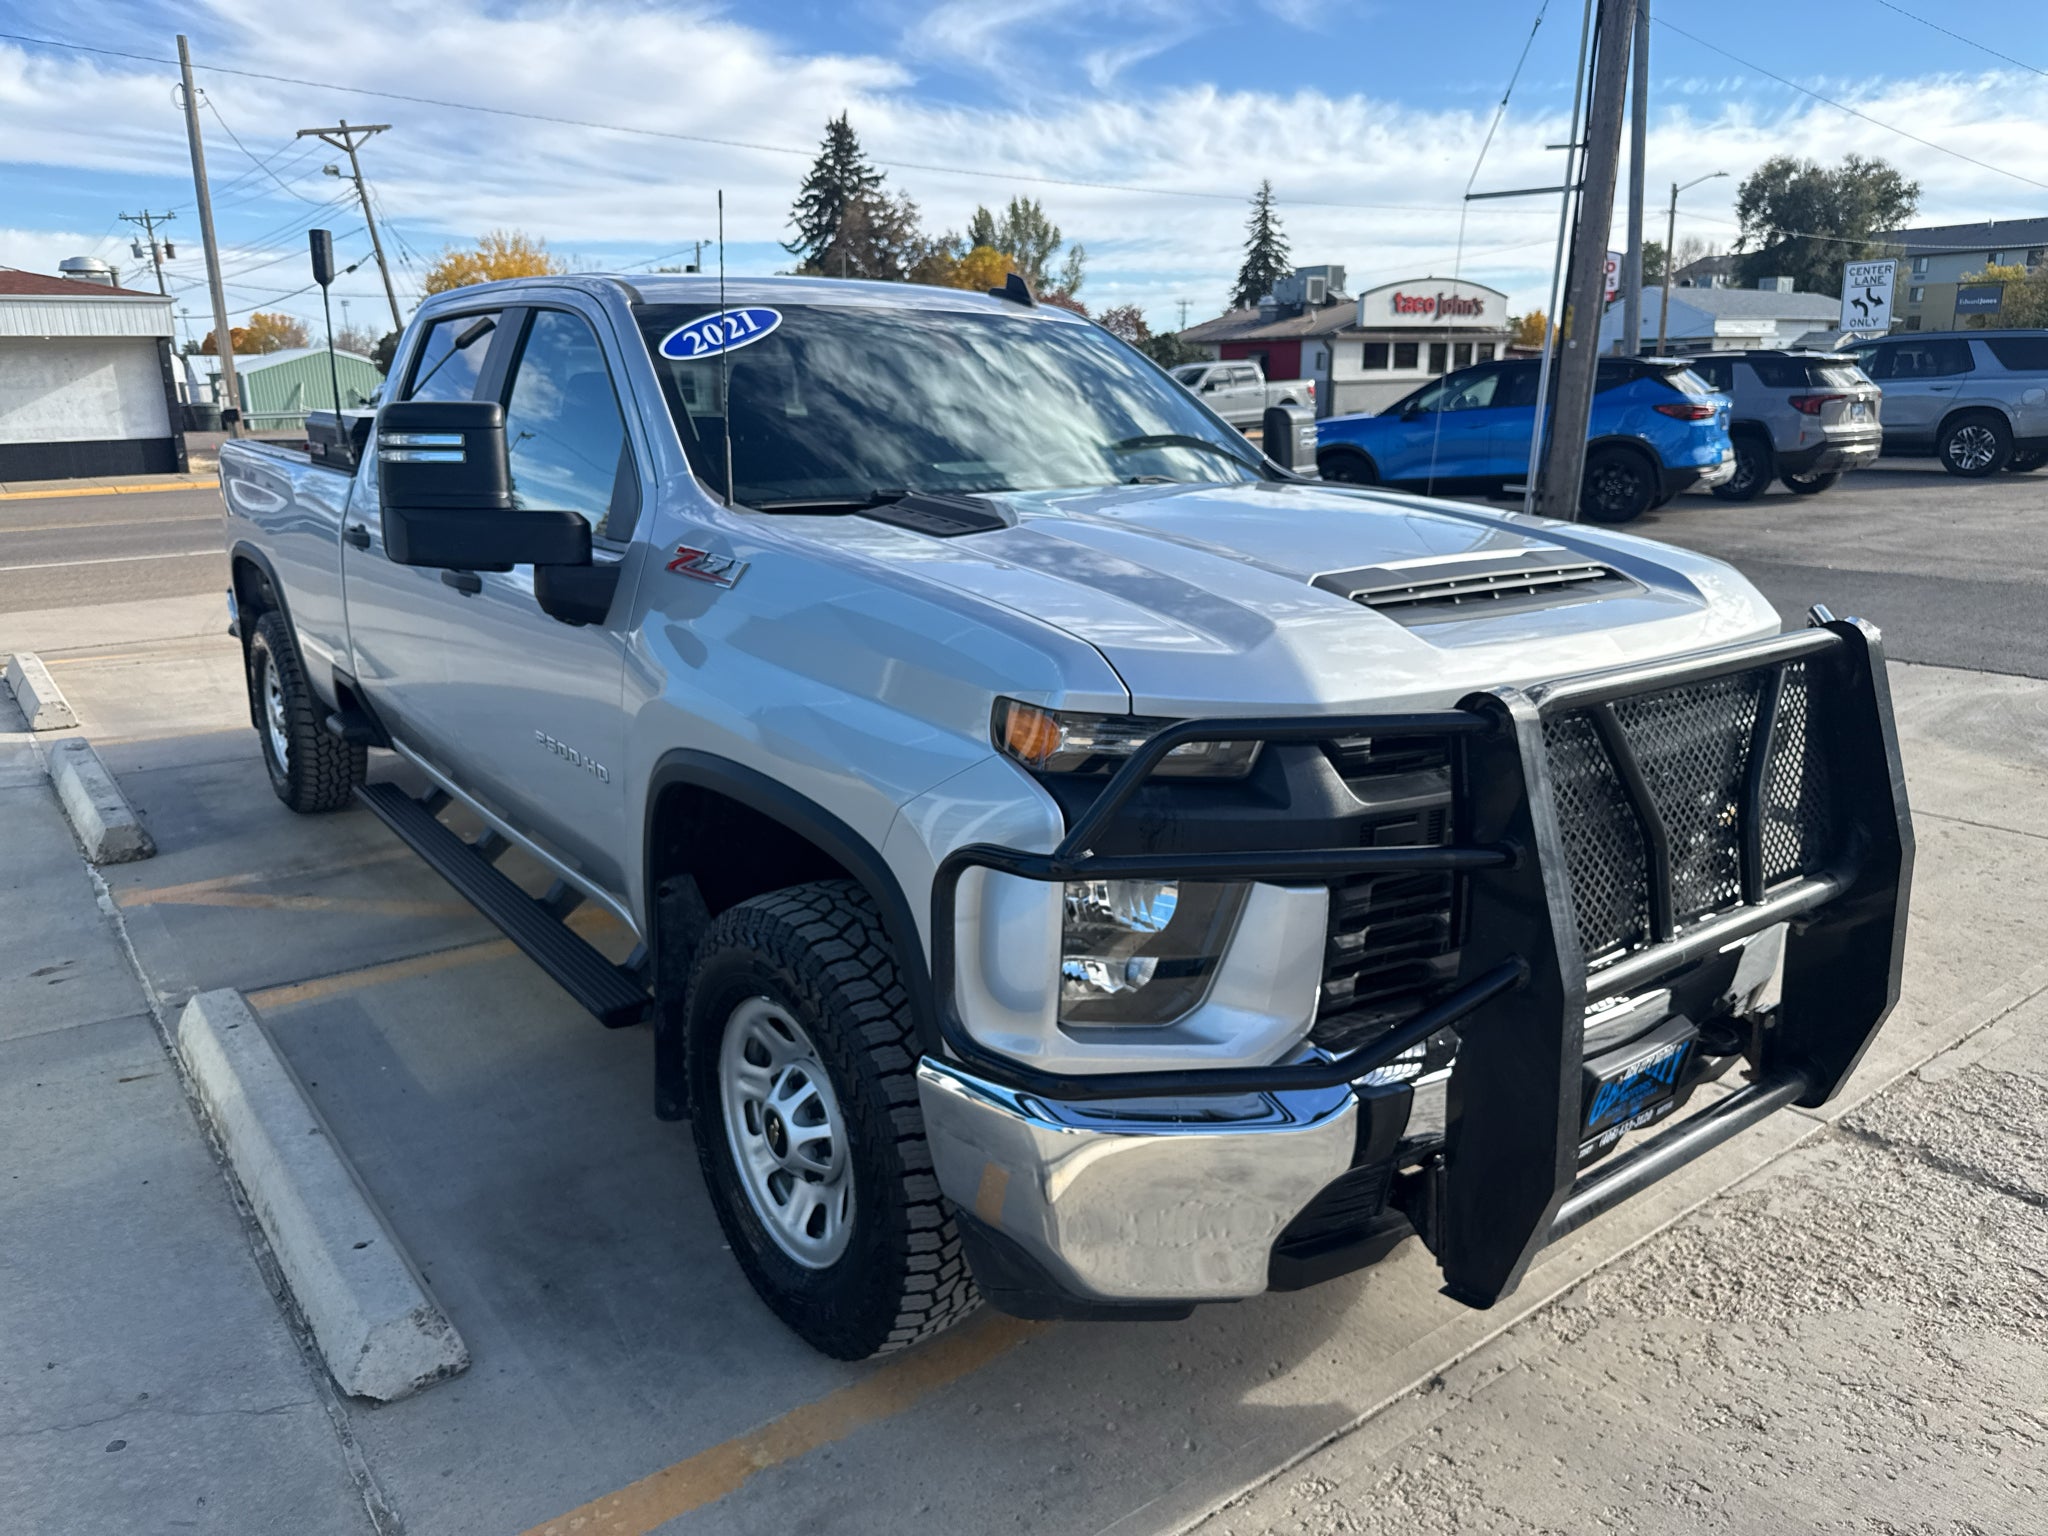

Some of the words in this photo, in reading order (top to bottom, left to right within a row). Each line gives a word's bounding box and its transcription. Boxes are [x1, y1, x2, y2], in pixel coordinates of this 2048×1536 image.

[1848, 264, 1893, 277] CENTER
[1854, 275, 1885, 286] LANE
[1393, 292, 1435, 314] taco
[1849, 317, 1879, 328] ONLY
[682, 311, 762, 355] 2021
[666, 544, 751, 590] Z71
